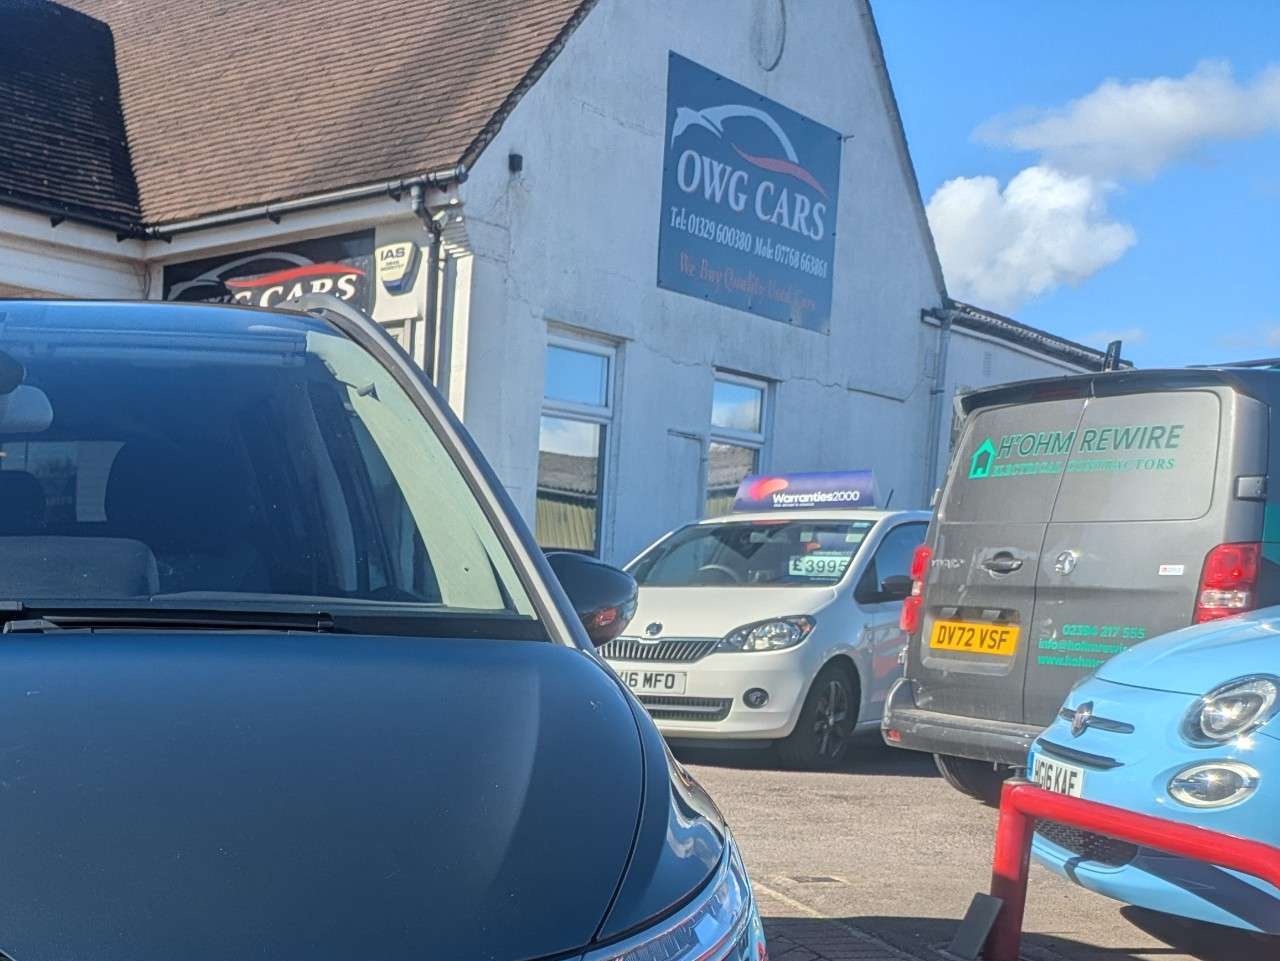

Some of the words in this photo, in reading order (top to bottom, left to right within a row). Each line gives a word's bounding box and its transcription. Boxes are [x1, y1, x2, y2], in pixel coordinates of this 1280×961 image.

[677, 149, 749, 212] OWG
[755, 180, 826, 241] CARS
[670, 206, 687, 230] Tel:
[380, 247, 405, 261] IAS
[1079, 424, 1185, 452] REWIRE
[772, 490, 860, 504] Warranties2000
[936, 625, 976, 647] DV72
[979, 628, 1010, 650] VSF
[642, 672, 676, 690] MFO
